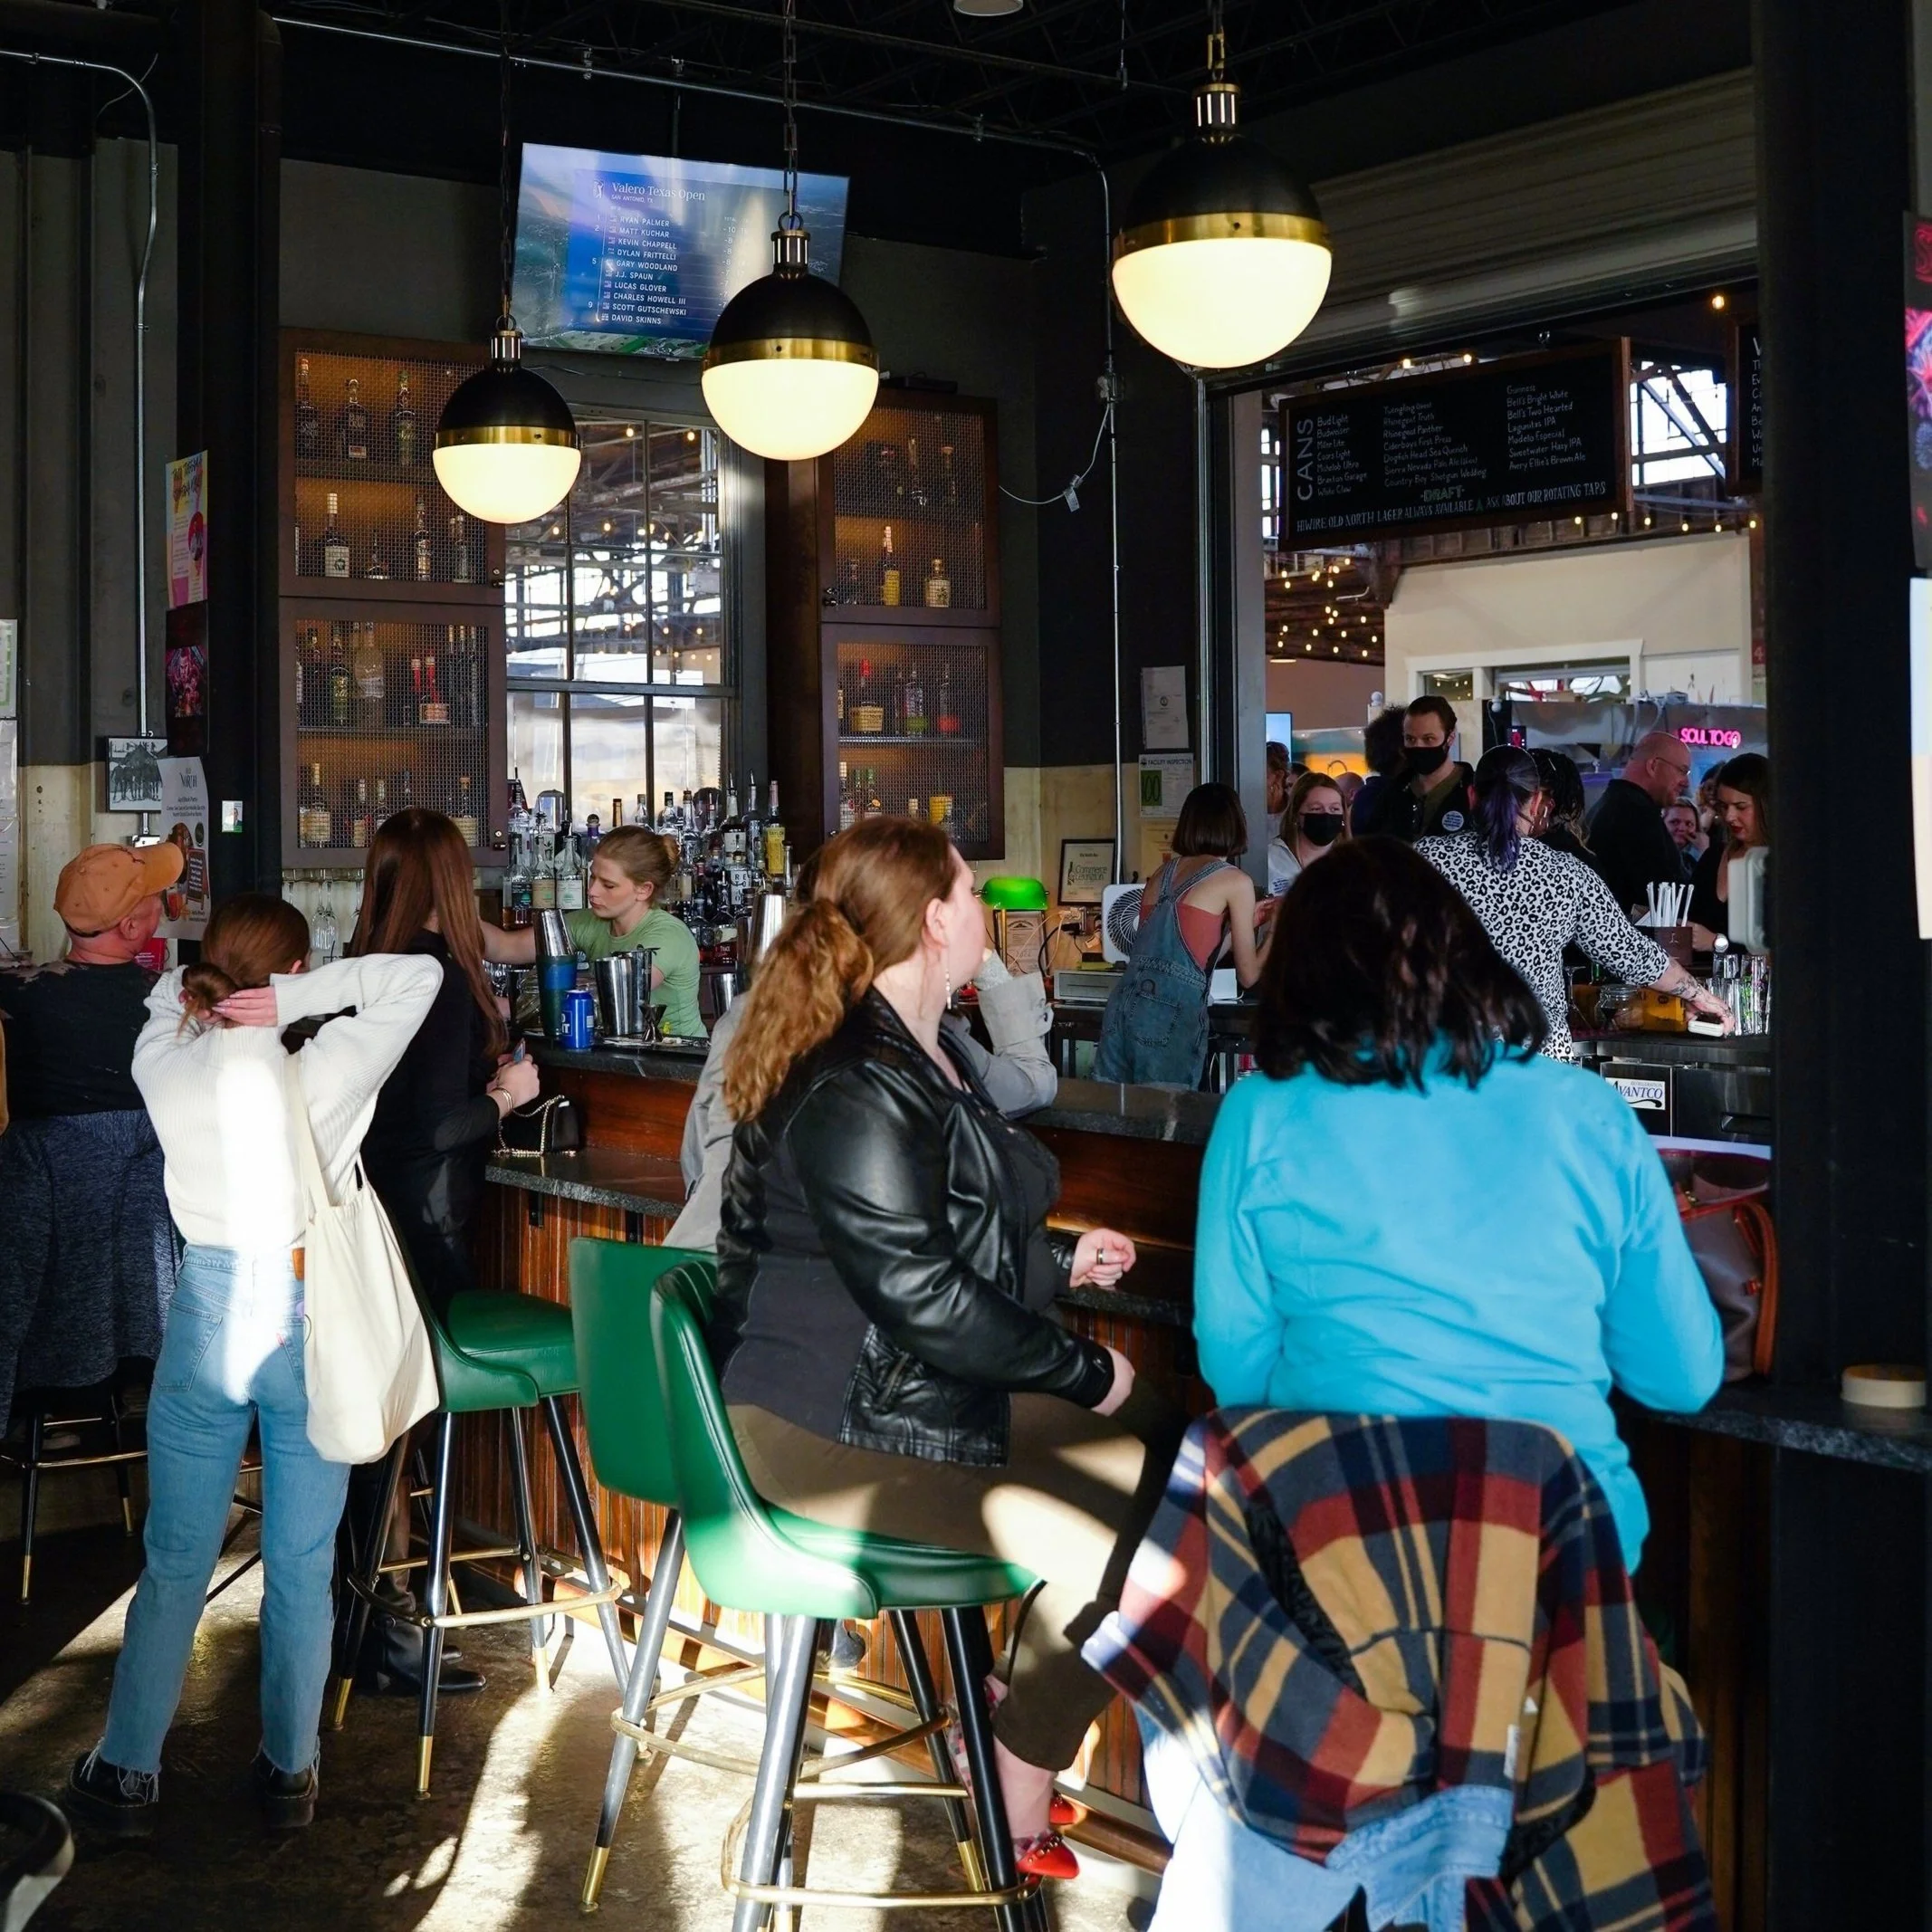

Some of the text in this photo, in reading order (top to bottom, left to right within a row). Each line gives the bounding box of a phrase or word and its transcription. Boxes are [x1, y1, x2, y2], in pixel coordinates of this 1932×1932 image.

[612, 182, 705, 201] Valero Texas Open
[620, 216, 639, 225] RYAN
[642, 217, 670, 227] PALMER
[641, 228, 670, 238] KUCHAR
[642, 240, 677, 250] CHAPPELL
[617, 249, 640, 257] DYLAN
[643, 251, 676, 261] FRITTELLI
[617, 260, 635, 268] GARY
[637, 262, 678, 272] WOODLAND
[629, 272, 654, 281] SPAUN
[614, 282, 636, 291] LUCAS
[639, 283, 667, 292] GLOVER
[613, 292, 645, 301] CHARLES
[647, 295, 675, 304] HOWELL
[612, 303, 636, 311] SCOTT
[637, 305, 687, 316] GUTSCHEWSKI
[611, 314, 662, 324] DAVID SKINNS
[1506, 390, 1569, 407] Bell's Bright White
[1418, 412, 1435, 421] Truth
[1506, 401, 1573, 420] Bell's Two Hearted
[1317, 414, 1349, 427] Bud Light
[1507, 416, 1556, 435] Lagunitas IPA
[1417, 424, 1444, 435] Panther
[1507, 427, 1564, 445] Modelo Especial
[1419, 435, 1433, 445] First
[1434, 435, 1452, 444] Press
[1509, 437, 1583, 458] Sweetwater Hazy IPA
[1296, 418, 1314, 502] CANS
[1317, 450, 1351, 462] Coors Light
[1383, 453, 1409, 464] Dogfish
[1410, 449, 1428, 460] Head
[1429, 447, 1441, 457] Sea
[1509, 451, 1586, 471] Avery Ellie's Brown Ale
[1343, 461, 1360, 470] Ultra
[1384, 465, 1406, 475] Sierra
[1407, 462, 1432, 472] Nevada
[1384, 468, 1487, 488] Country Boy Shotgun Wedding
[1328, 515, 1344, 528] OLD
[1344, 512, 1374, 527] NORTH
[1377, 508, 1402, 522] LAGER
[1405, 504, 1432, 519] ALWAYS
[1435, 500, 1474, 515] AVAILABLE
[1486, 496, 1500, 509] ASK
[1500, 492, 1526, 507] ABOUT
[1527, 490, 1543, 503] OUR
[1543, 484, 1582, 502] ROTATING
[1583, 481, 1607, 496] TAPS
[1680, 728, 1708, 744] SOUL
[1141, 775, 1161, 802] 100
